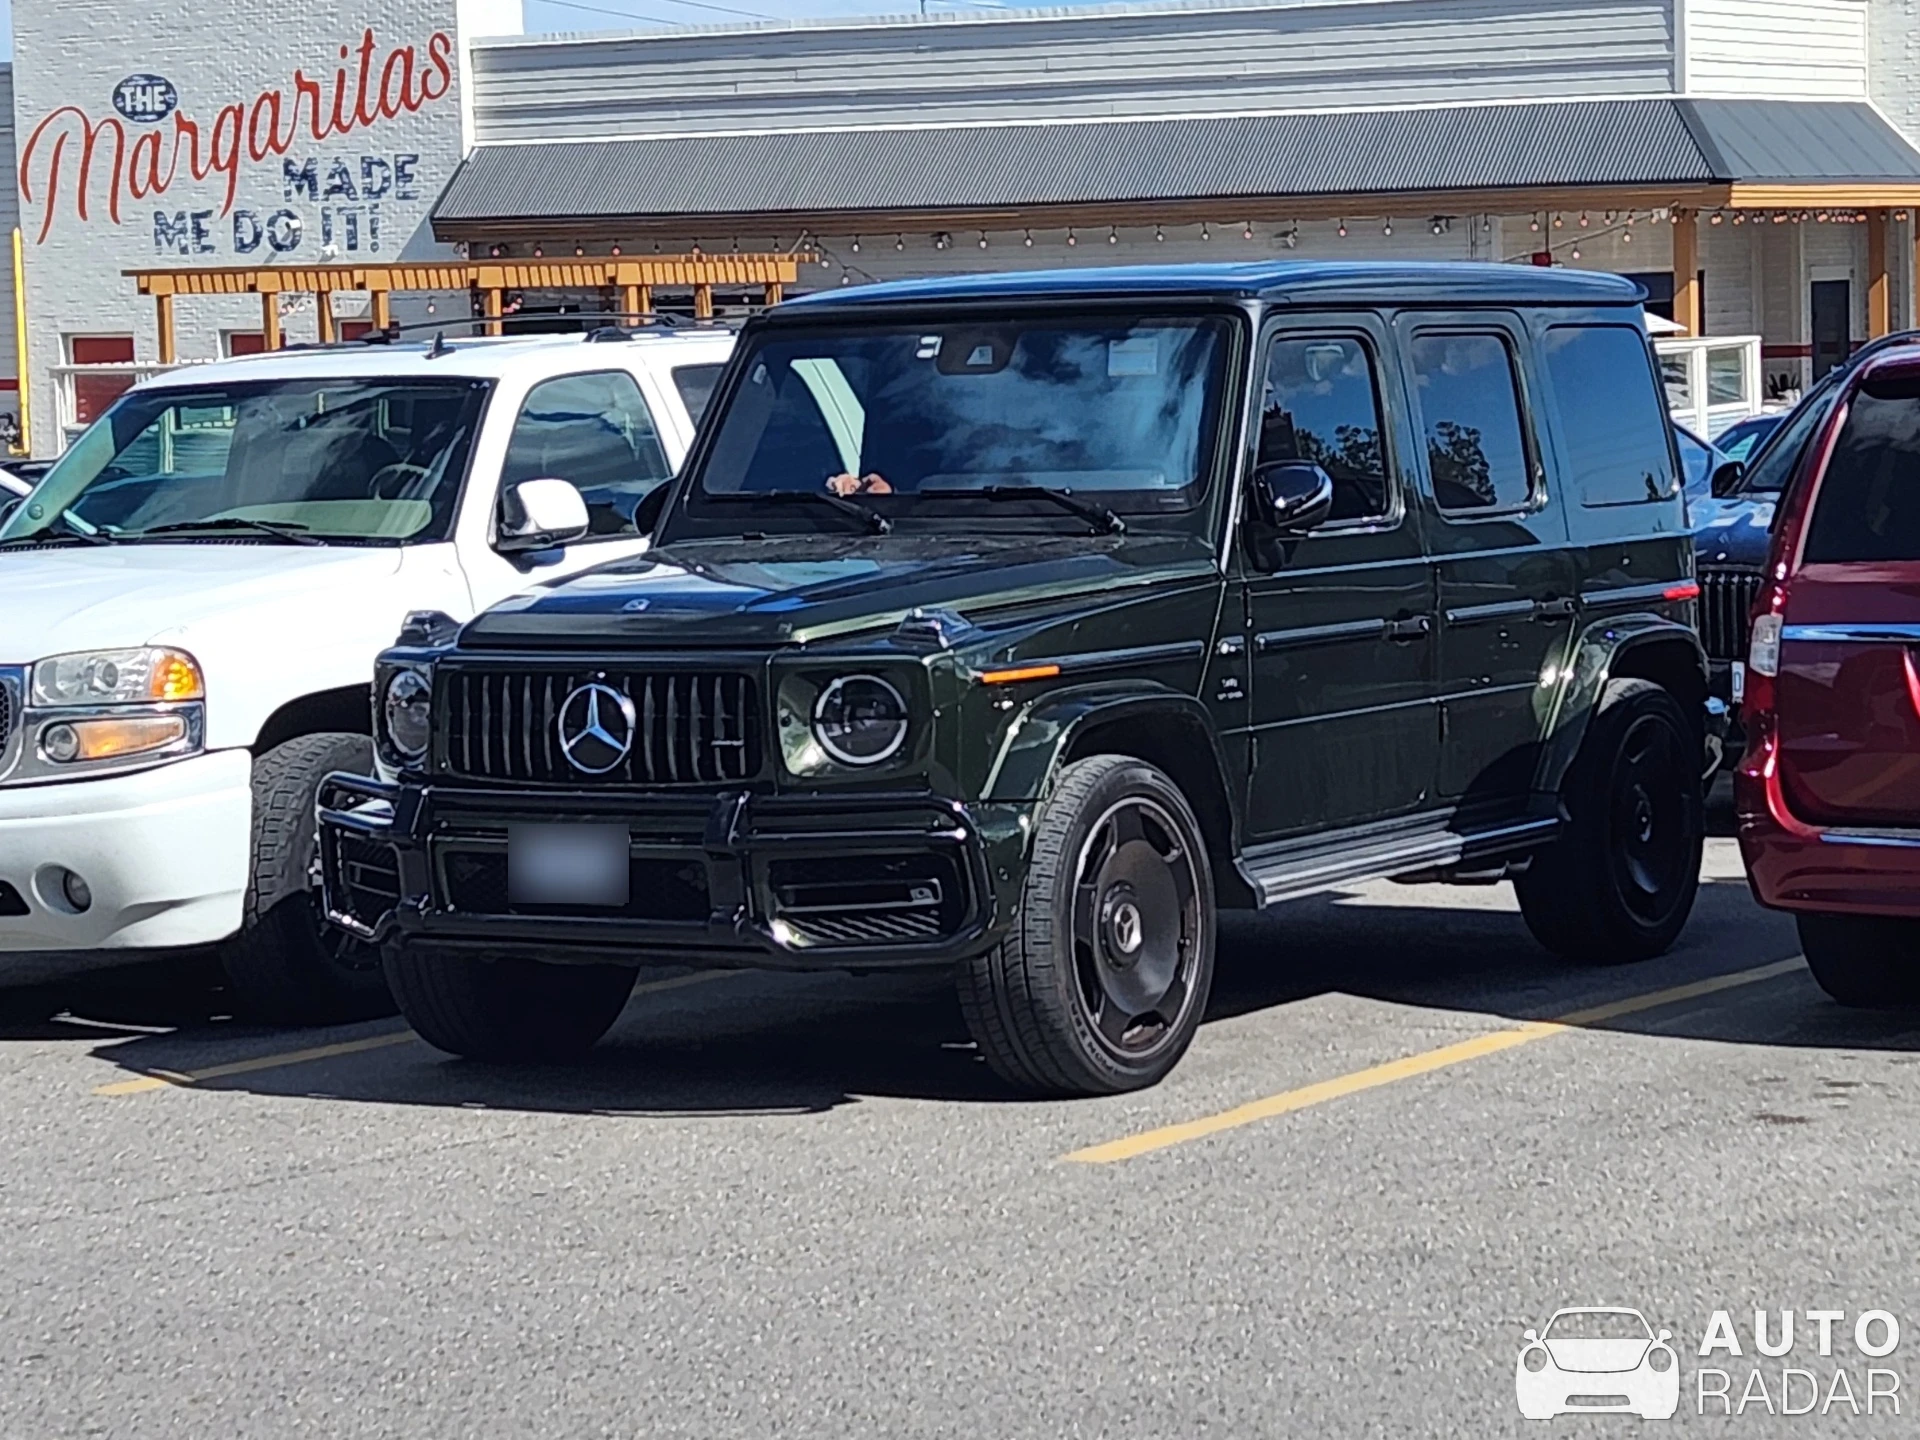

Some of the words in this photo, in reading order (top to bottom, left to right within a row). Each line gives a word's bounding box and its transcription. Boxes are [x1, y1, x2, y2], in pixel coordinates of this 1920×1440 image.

[120, 85, 167, 112] THE
[20, 28, 452, 245] Margaritas
[283, 153, 419, 202] MADE
[154, 210, 215, 255] ME
[234, 209, 301, 253] DO
[322, 204, 380, 254] IT!
